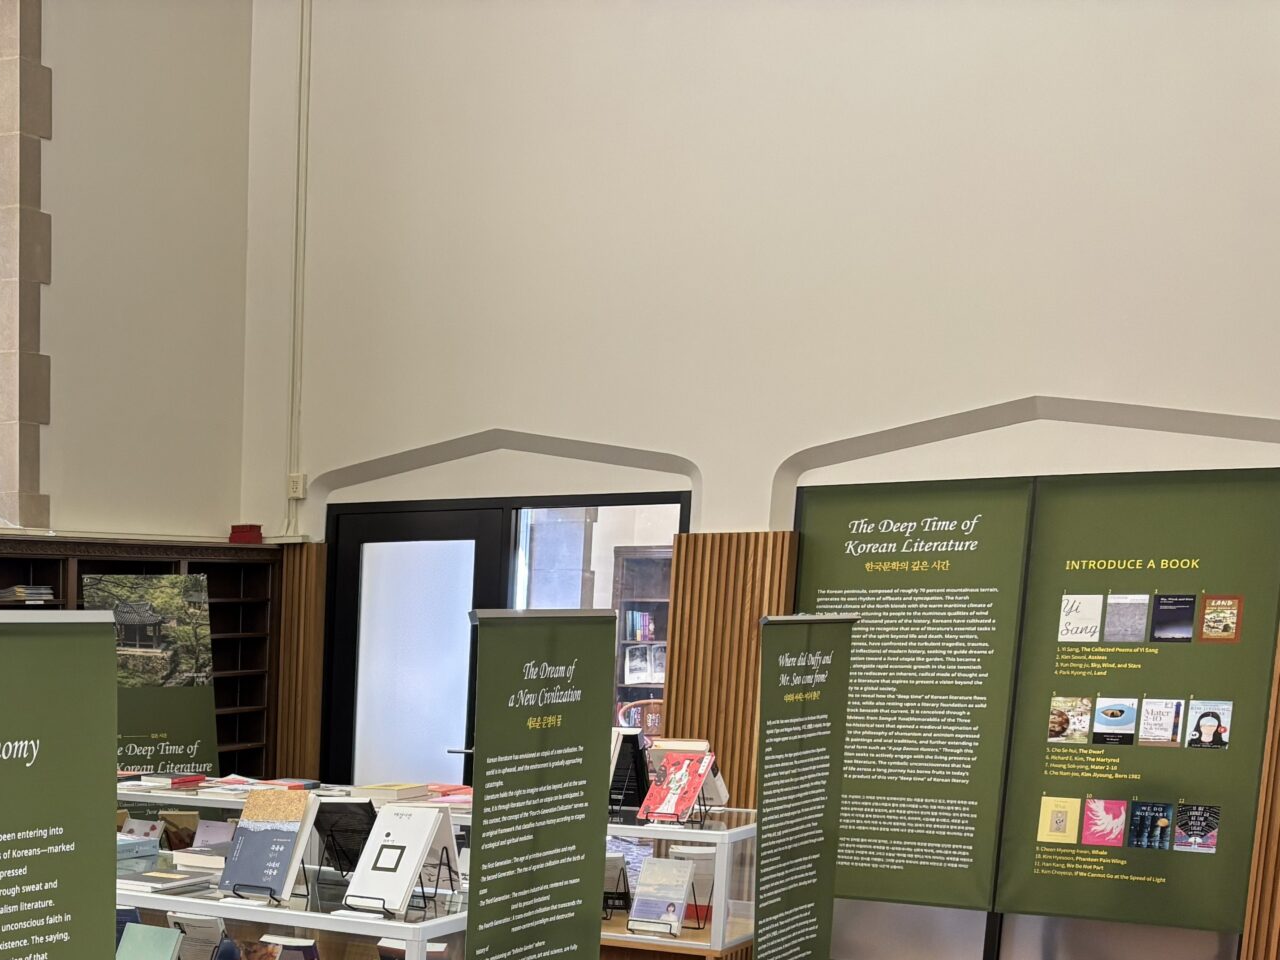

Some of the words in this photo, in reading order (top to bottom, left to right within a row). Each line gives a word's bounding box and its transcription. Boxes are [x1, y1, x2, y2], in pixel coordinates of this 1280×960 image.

[848, 519, 875, 534] The
[878, 520, 916, 536] Deep
[921, 517, 957, 532] Time
[961, 515, 982, 534] of
[845, 540, 896, 556] Korean
[901, 538, 978, 552] Literature
[931, 560, 950, 571] 시간
[1066, 560, 1142, 570] INTRODUCE
[1147, 560, 1156, 568] A
[1160, 559, 1200, 568] BOOK
[1062, 599, 1080, 616] Yi
[1061, 622, 1098, 637] Sang
[778, 653, 797, 667] Where
[797, 652, 808, 666] did
[807, 651, 822, 669] Duffy
[822, 650, 834, 664] and
[523, 660, 538, 679] The
[540, 662, 565, 678] Dream
[567, 659, 577, 683] of
[779, 674, 789, 686] Mr.
[802, 675, 813, 684] come
[812, 670, 828, 687] from?
[509, 695, 515, 707] a
[516, 689, 537, 707] New
[539, 685, 581, 707] Civilization
[125, 744, 155, 759] Deep
[157, 742, 184, 754] Time
[187, 740, 200, 757] of
[157, 761, 212, 773] Literature
[17, 828, 48, 839] entering
[49, 827, 64, 835] into
